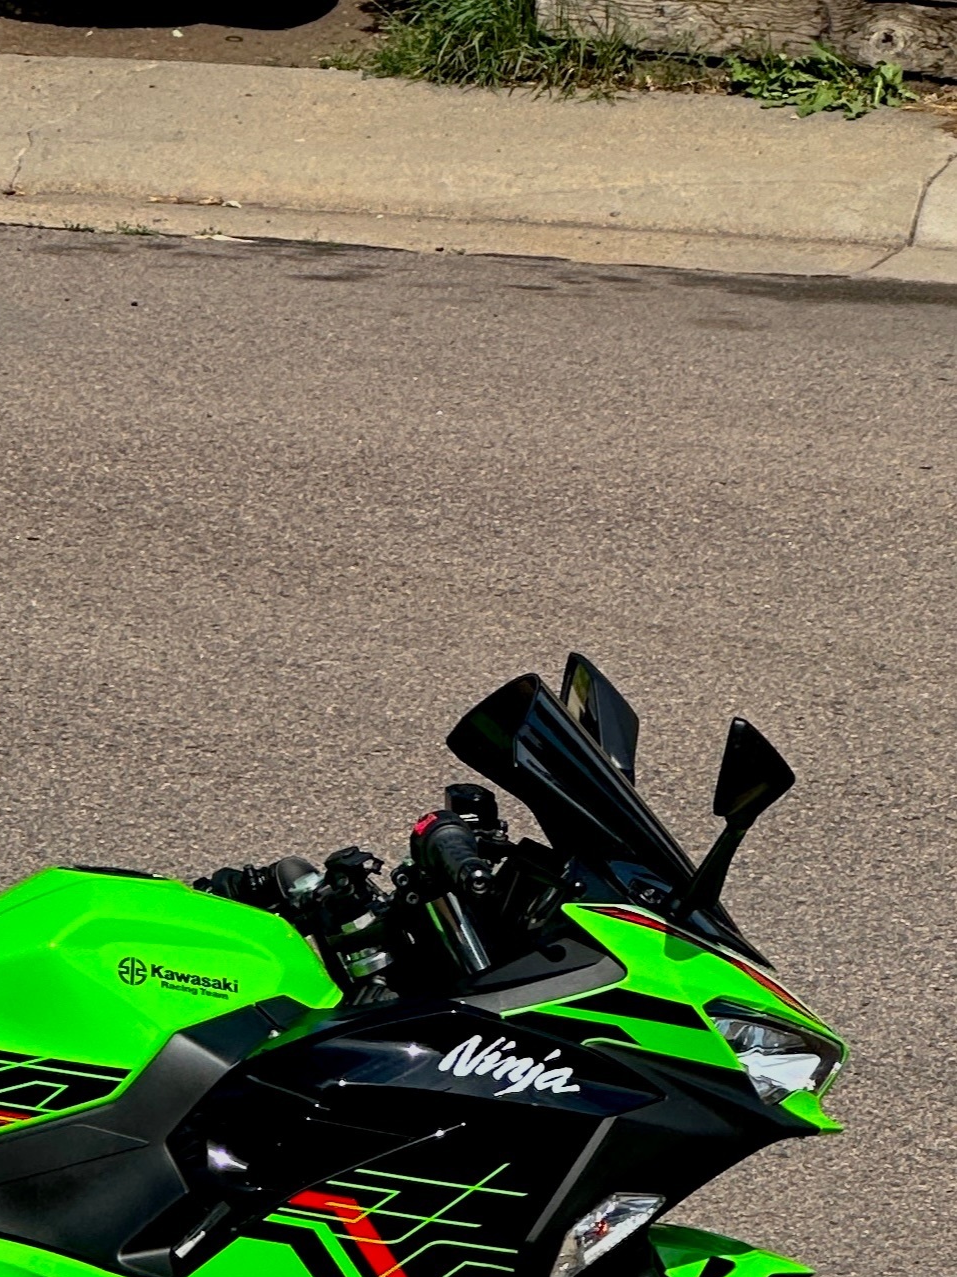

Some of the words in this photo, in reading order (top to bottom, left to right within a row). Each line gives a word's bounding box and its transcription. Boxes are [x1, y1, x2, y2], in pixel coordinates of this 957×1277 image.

[150, 964, 239, 993] Kawasaki
[160, 980, 199, 996] Racing
[200, 987, 230, 1000] Team
[438, 1034, 581, 1097] Ninja
